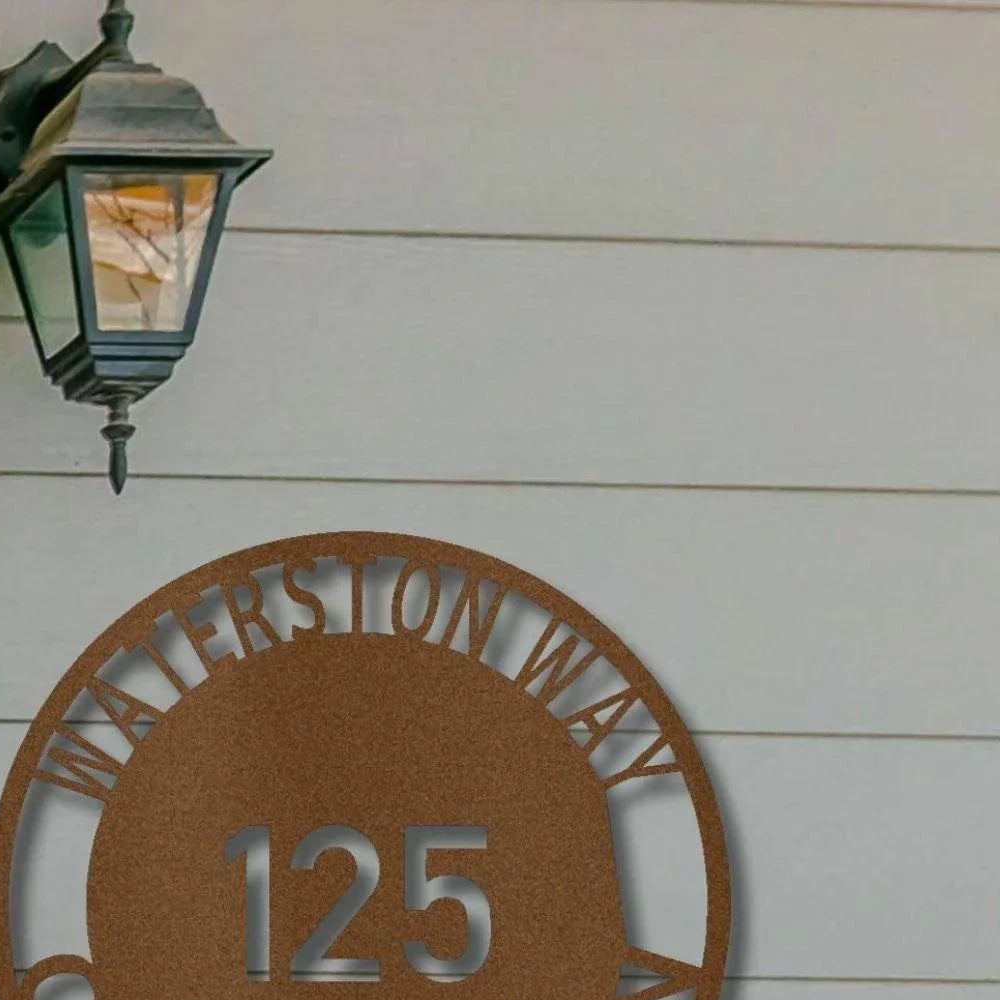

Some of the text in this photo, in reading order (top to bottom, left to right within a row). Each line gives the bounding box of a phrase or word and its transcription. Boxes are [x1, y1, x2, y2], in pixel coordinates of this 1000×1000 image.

[31, 555, 686, 800] WATERSTON WAY
[223, 825, 491, 983] 125
